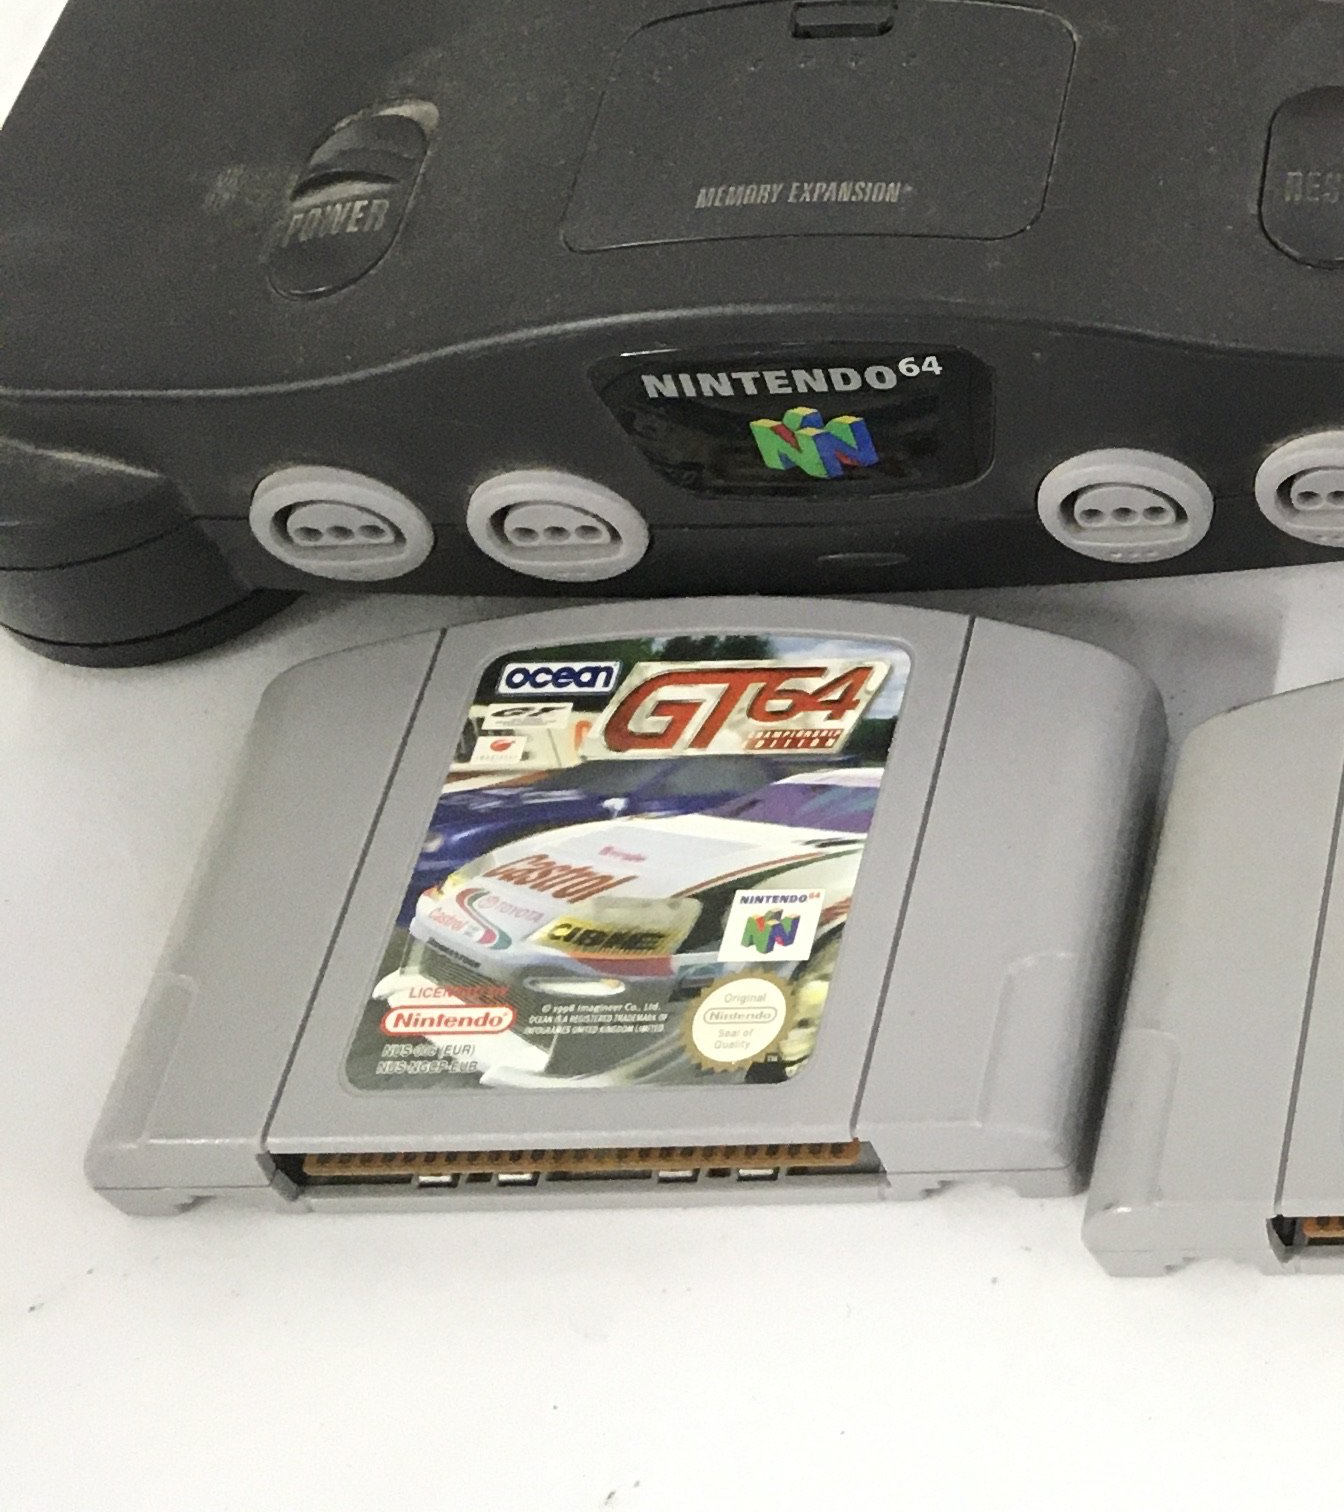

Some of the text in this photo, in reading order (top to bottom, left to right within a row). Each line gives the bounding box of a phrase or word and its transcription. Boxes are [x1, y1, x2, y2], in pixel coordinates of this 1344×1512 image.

[695, 181, 902, 208] MEMORY EXPANSION
[282, 199, 390, 248] POWER
[505, 665, 615, 689] ocean
[483, 853, 639, 905] Castrol
[497, 899, 545, 923] TOYOTA
[724, 993, 767, 1005] Original
[393, 1012, 501, 1029] Nintendo
[709, 1011, 772, 1022] Nintendo
[439, 1044, 476, 1059] (EUR)
